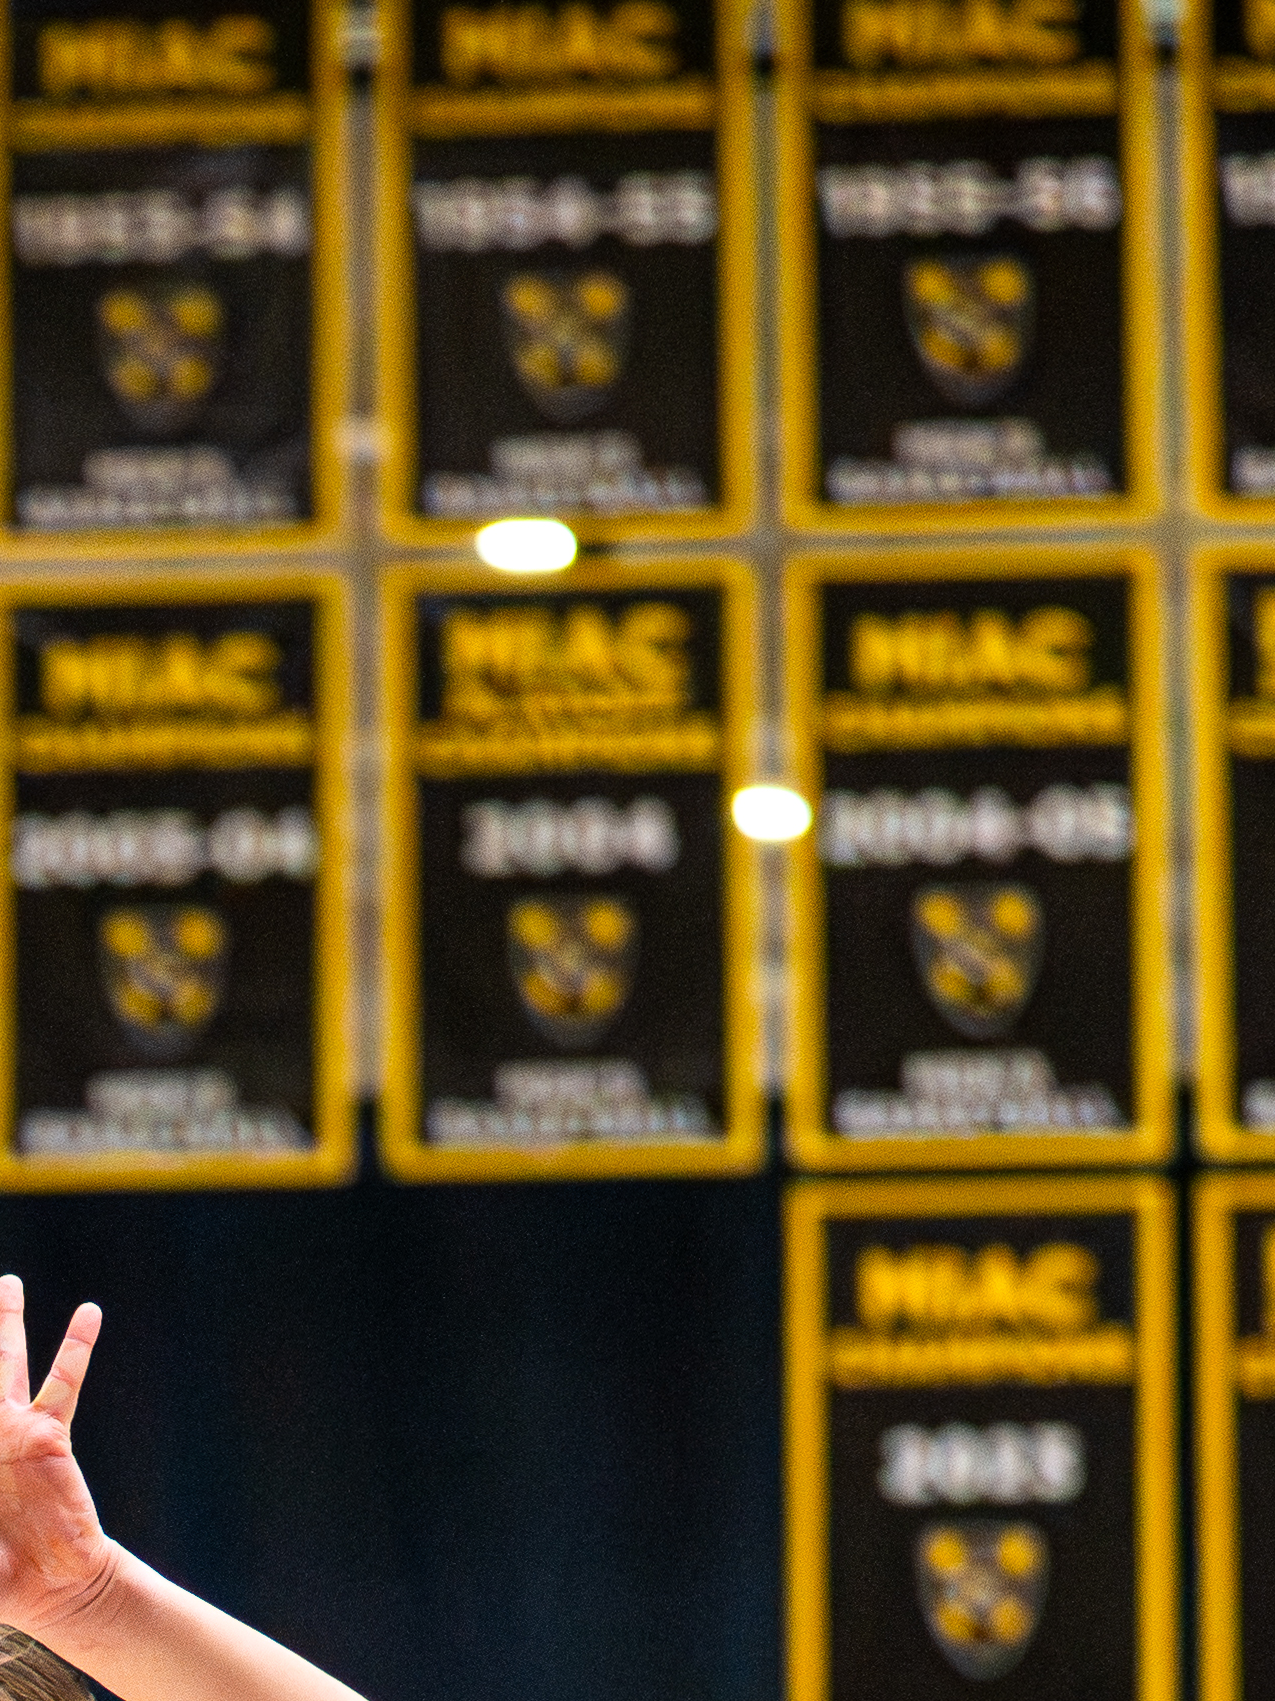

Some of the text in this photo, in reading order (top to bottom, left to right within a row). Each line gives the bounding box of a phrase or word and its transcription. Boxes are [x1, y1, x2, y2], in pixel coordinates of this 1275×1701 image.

[447, 9, 678, 79] MIAC
[47, 638, 278, 715] MIAC
[447, 610, 686, 684] MIAC
[856, 616, 1089, 694] MIAC
[468, 805, 672, 869] 2004
[824, 790, 1133, 858] 2004-05
[861, 1245, 1093, 1328] MIAC
